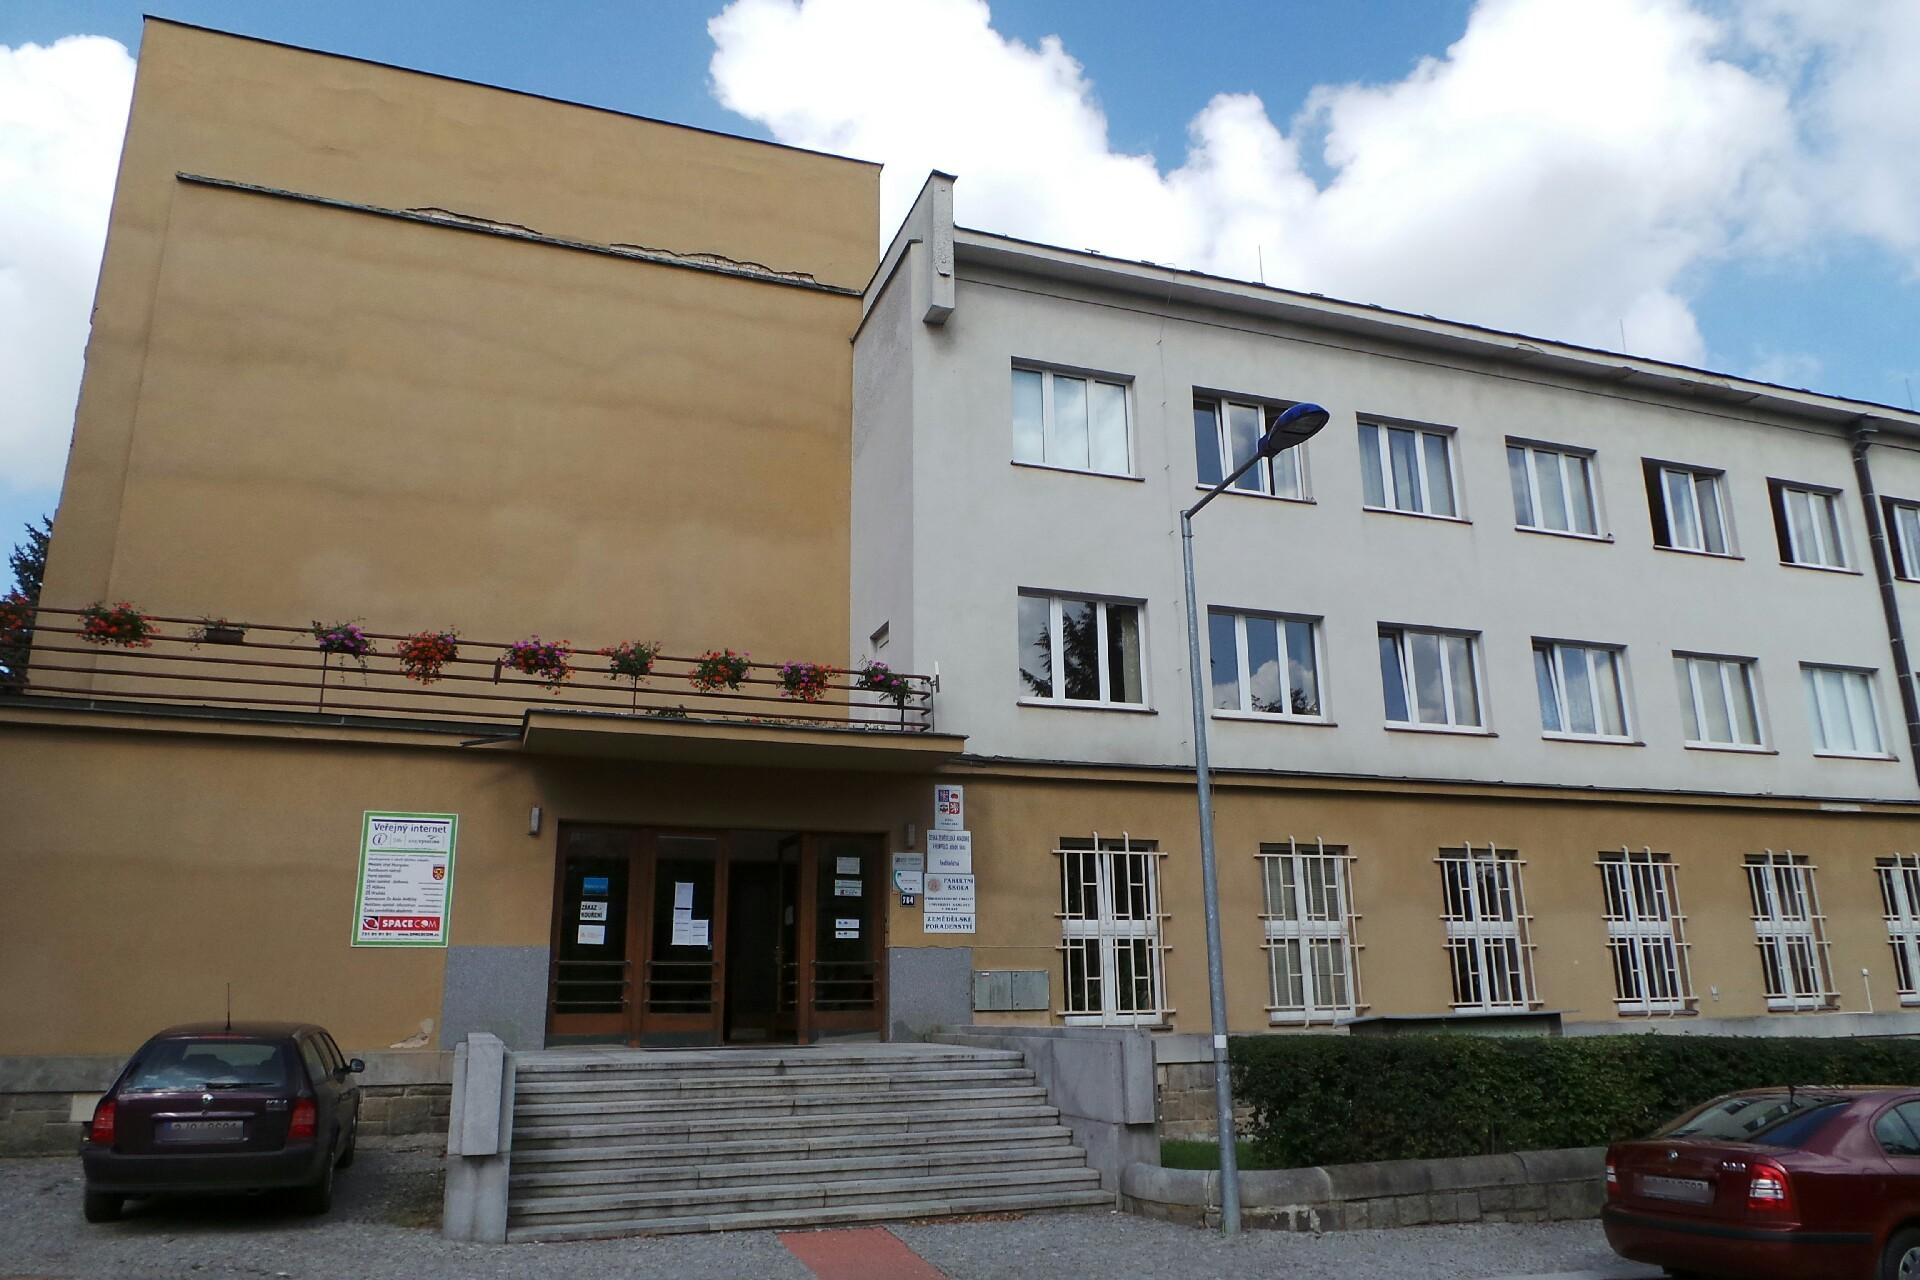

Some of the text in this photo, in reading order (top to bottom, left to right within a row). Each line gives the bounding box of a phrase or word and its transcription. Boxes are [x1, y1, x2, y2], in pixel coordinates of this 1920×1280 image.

[374, 823, 447, 834] Veřejný internet
[382, 919, 437, 928] SPACECOM
